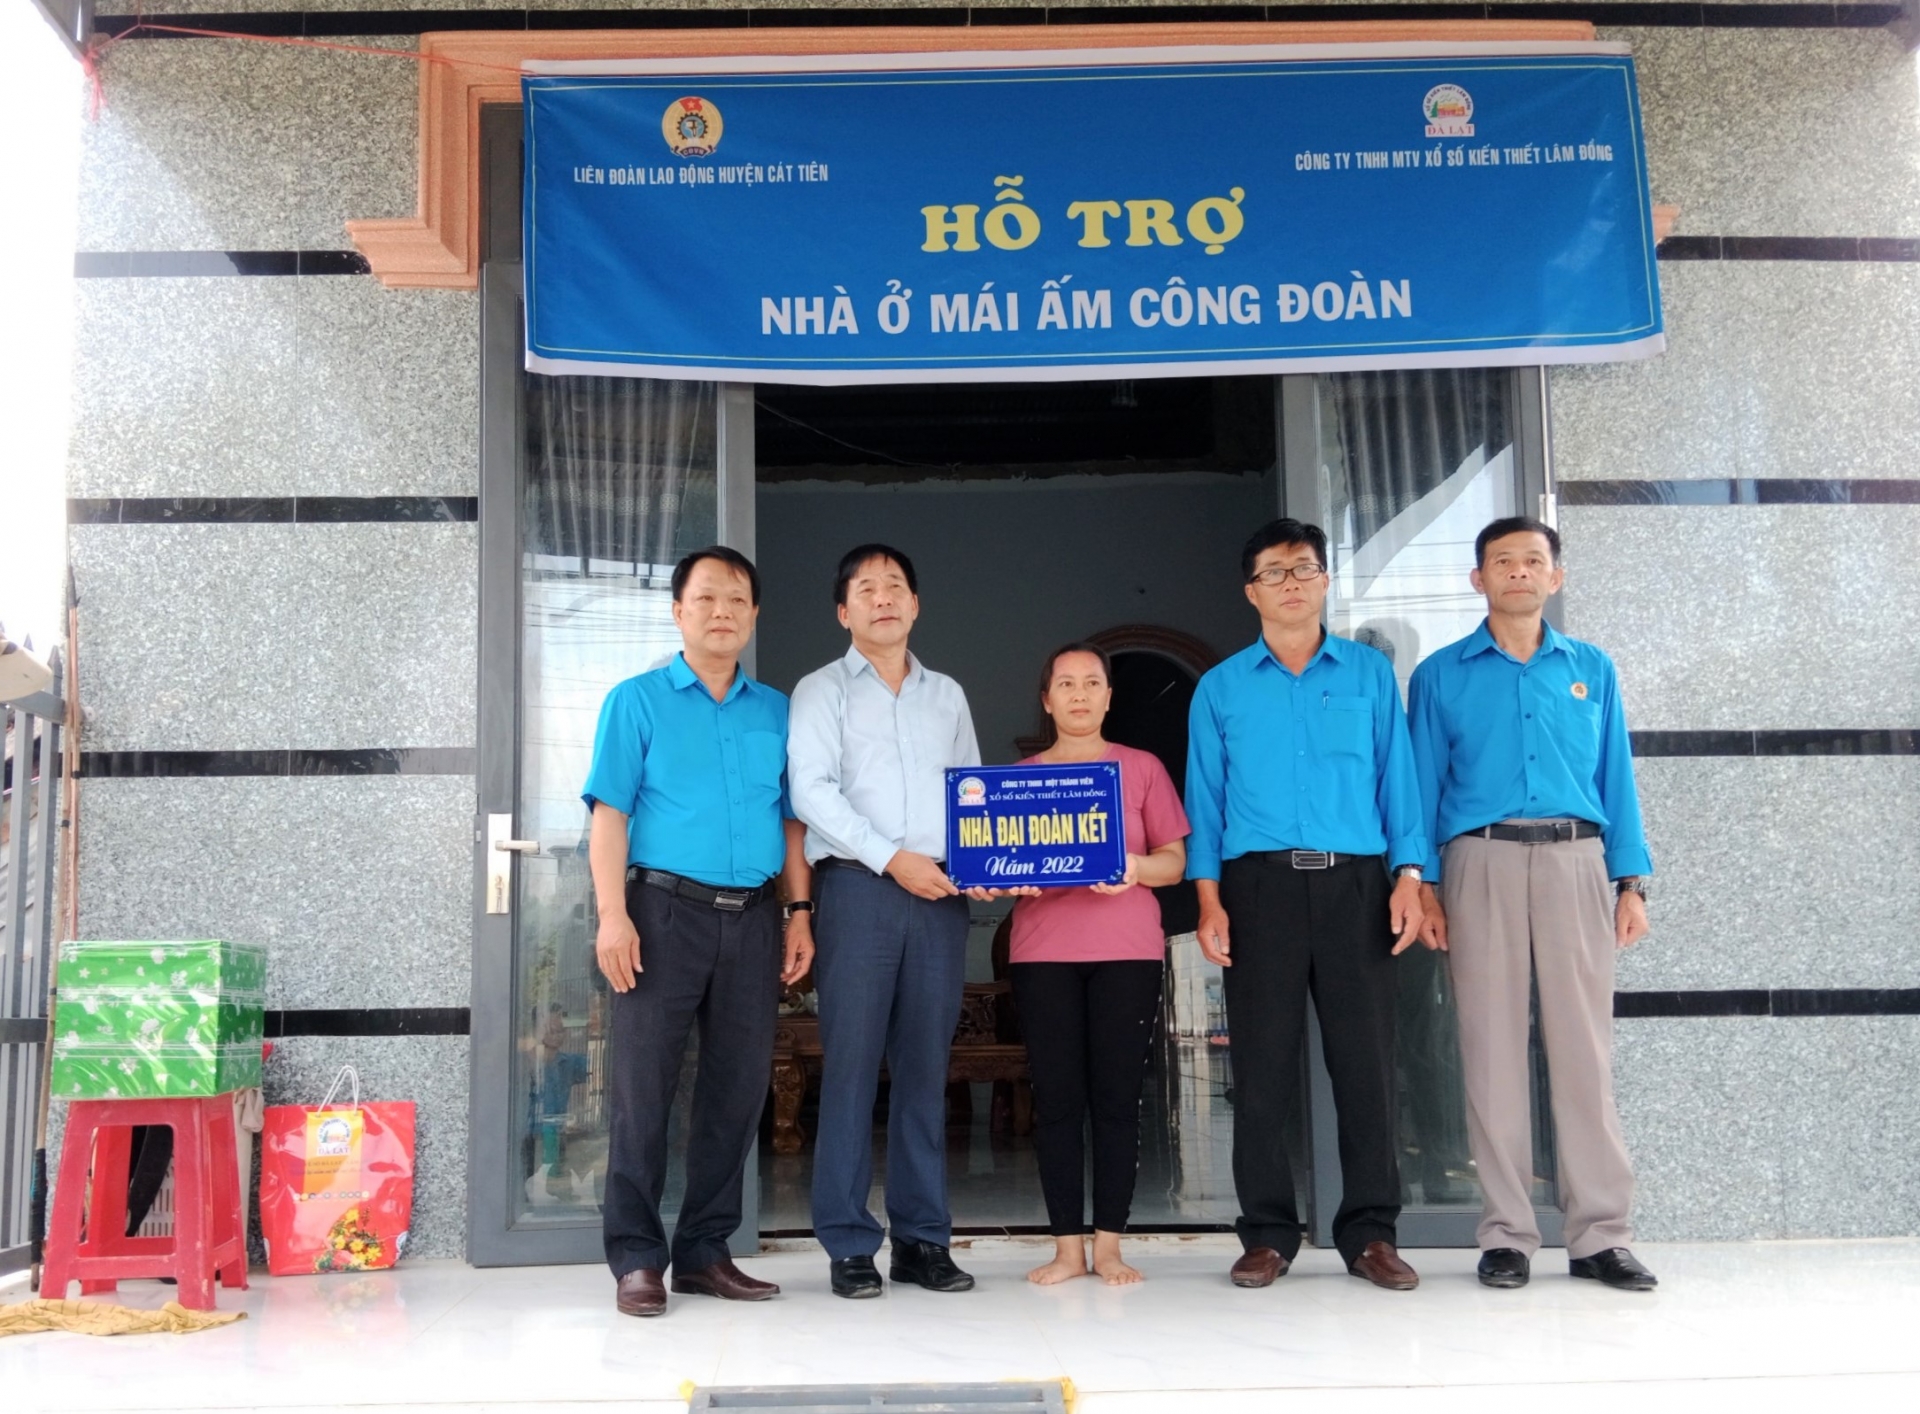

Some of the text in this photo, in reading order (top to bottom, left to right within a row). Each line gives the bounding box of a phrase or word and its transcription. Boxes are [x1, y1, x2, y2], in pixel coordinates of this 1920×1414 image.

[1295, 150, 1331, 171] CÔNG
[1334, 152, 1351, 170] TY
[1355, 151, 1389, 169] TNHH
[1392, 150, 1420, 168] MTV
[1425, 142, 1443, 168] XỔ
[1446, 144, 1465, 167] SỐ
[1468, 143, 1500, 166] KIẾN
[1503, 142, 1541, 165] THIẾT
[1545, 143, 1575, 163] LÂM
[573, 161, 829, 188] LIÊN ĐOÀN LAO ĐỘNG HUYỆN CÁT TIÊN
[920, 174, 1246, 256] HỖ TRỢ
[760, 270, 1413, 336] NHÀ Ở MÁI ẤM CÔNG ĐOÀN
[1001, 779, 1018, 789] CÔNG
[1015, 790, 1035, 800] KIẾN
[1036, 789, 1062, 799] THIẾT
[1063, 789, 1082, 799] LÂM
[958, 802, 1108, 853] NHÀ ĐẠI ĐOÀN KẾT
[985, 855, 1084, 877] Năm 2022
